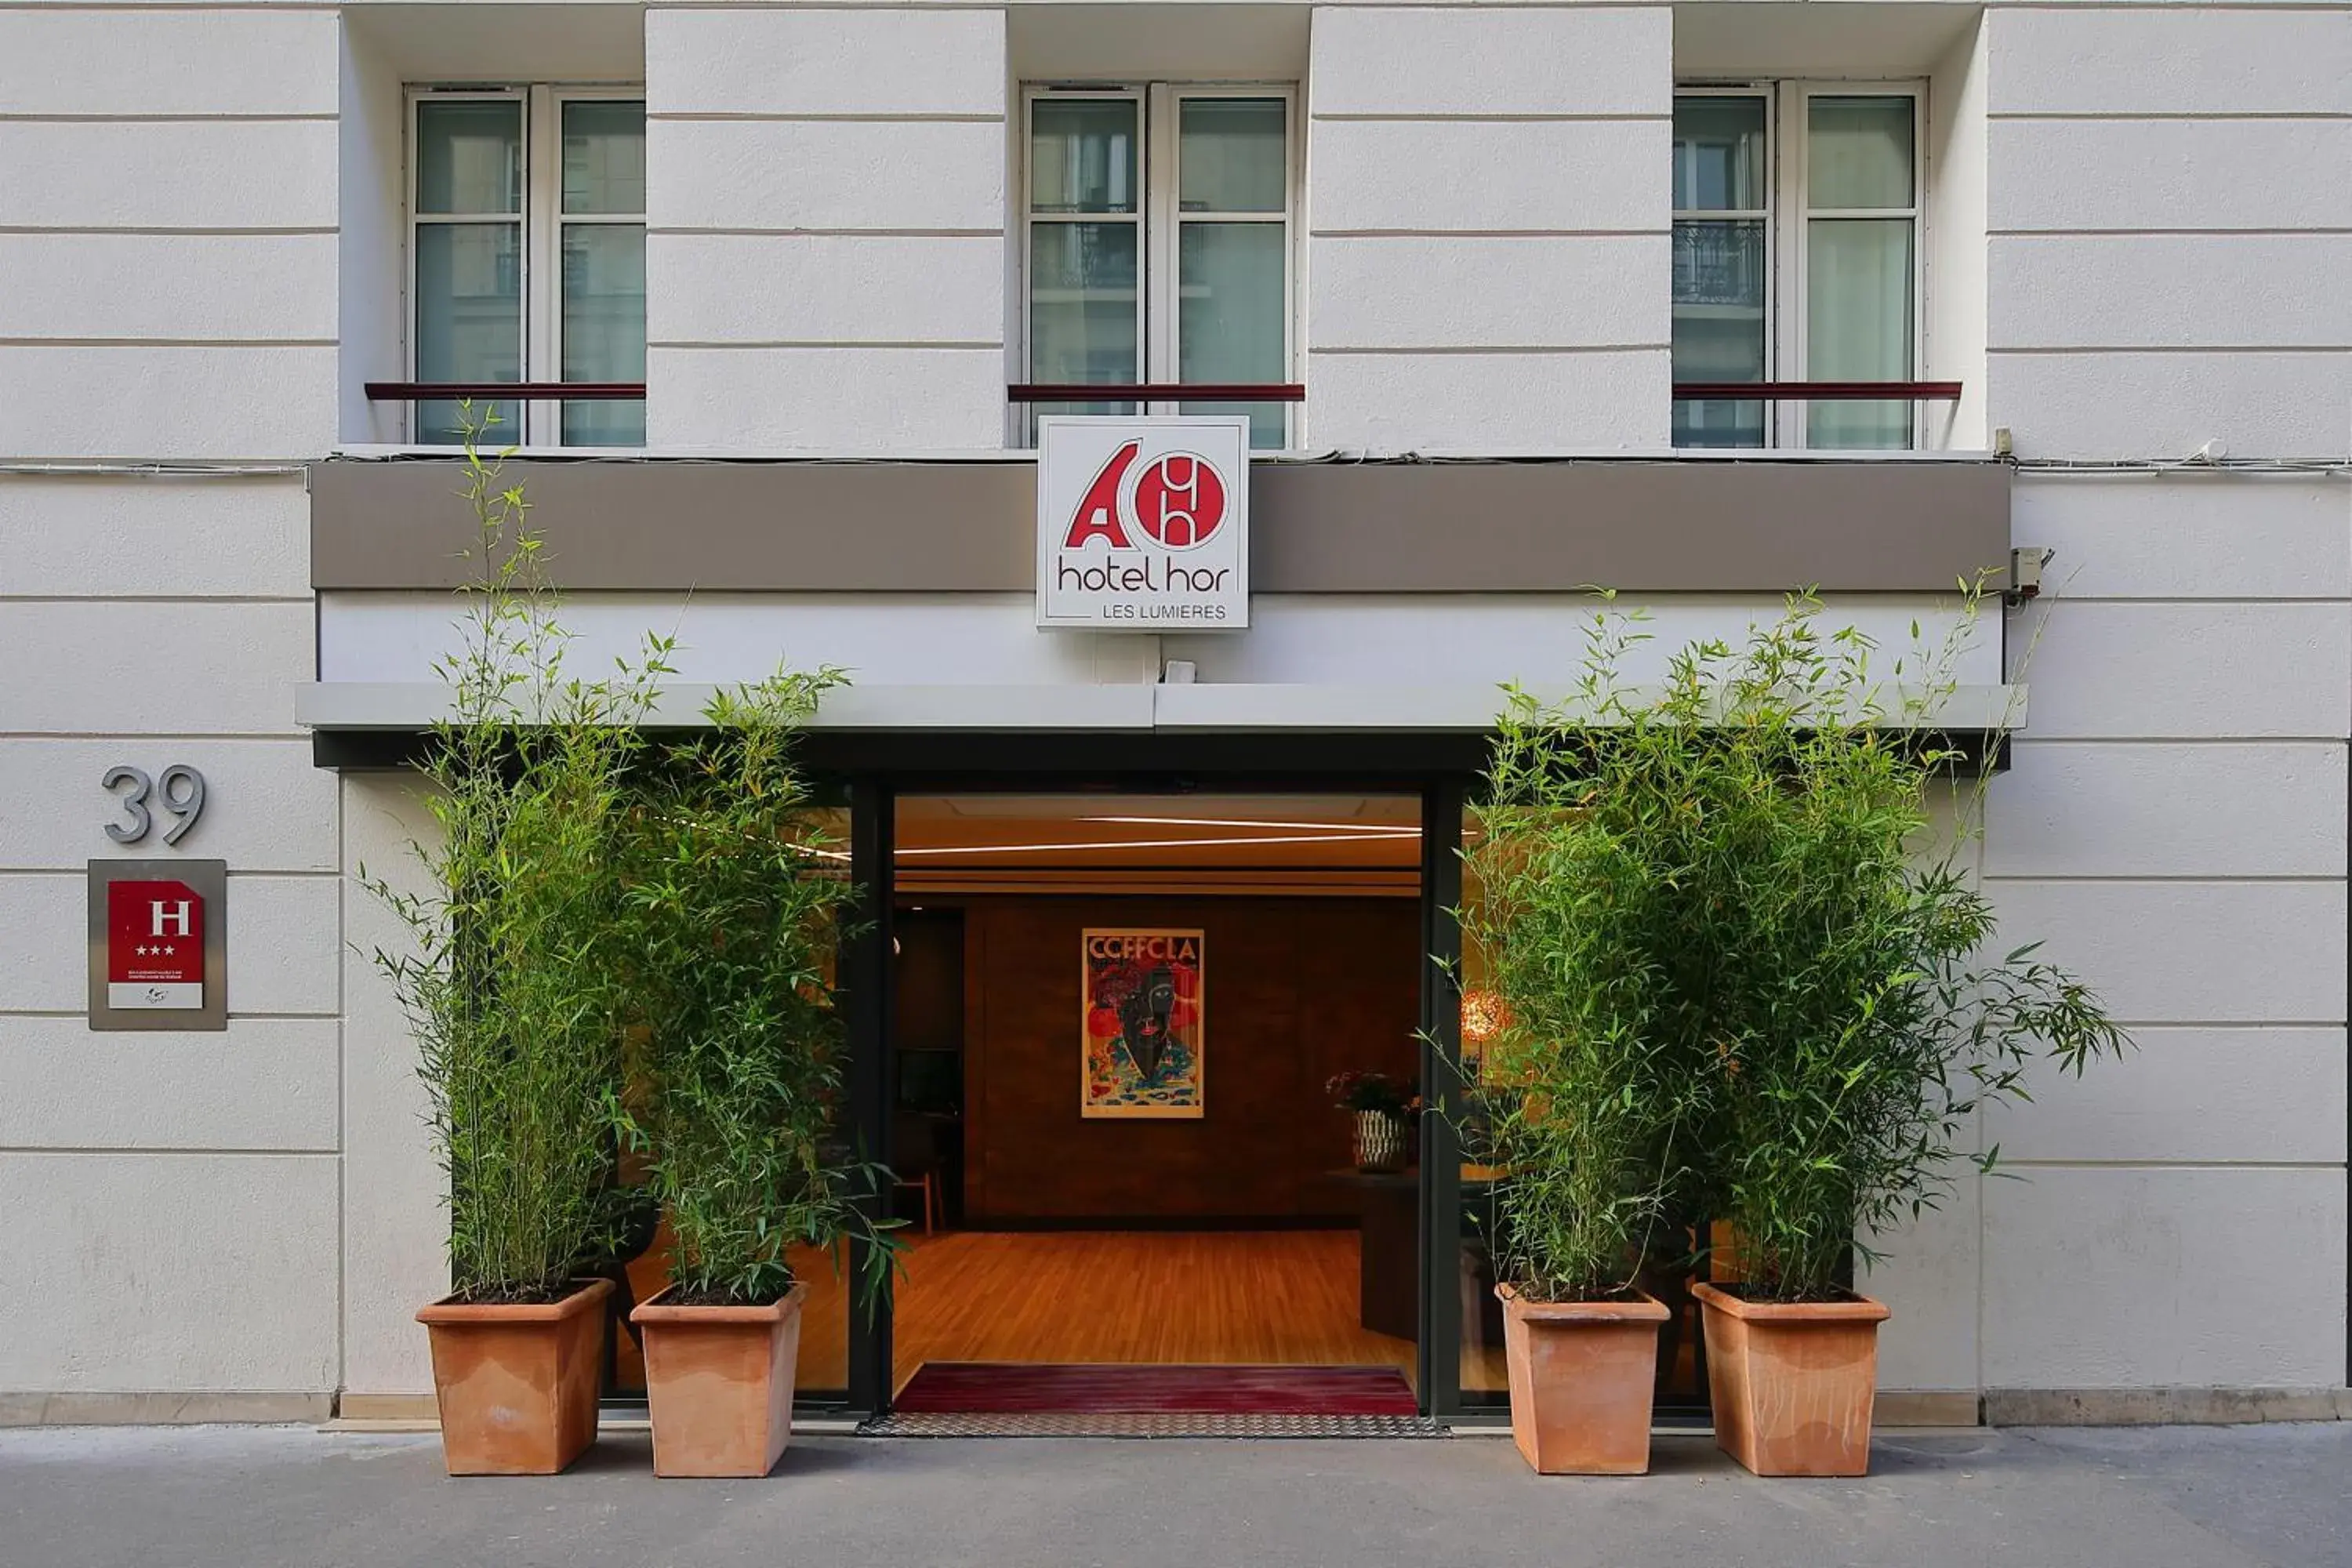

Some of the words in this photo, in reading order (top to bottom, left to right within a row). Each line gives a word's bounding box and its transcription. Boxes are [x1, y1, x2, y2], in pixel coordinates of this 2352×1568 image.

[1058, 555, 1158, 592] hotel
[1167, 555, 1230, 592] hor
[1102, 604, 1134, 619] LES
[1140, 604, 1226, 619] LUMIERES
[102, 764, 206, 847] 39
[148, 899, 193, 937] H
